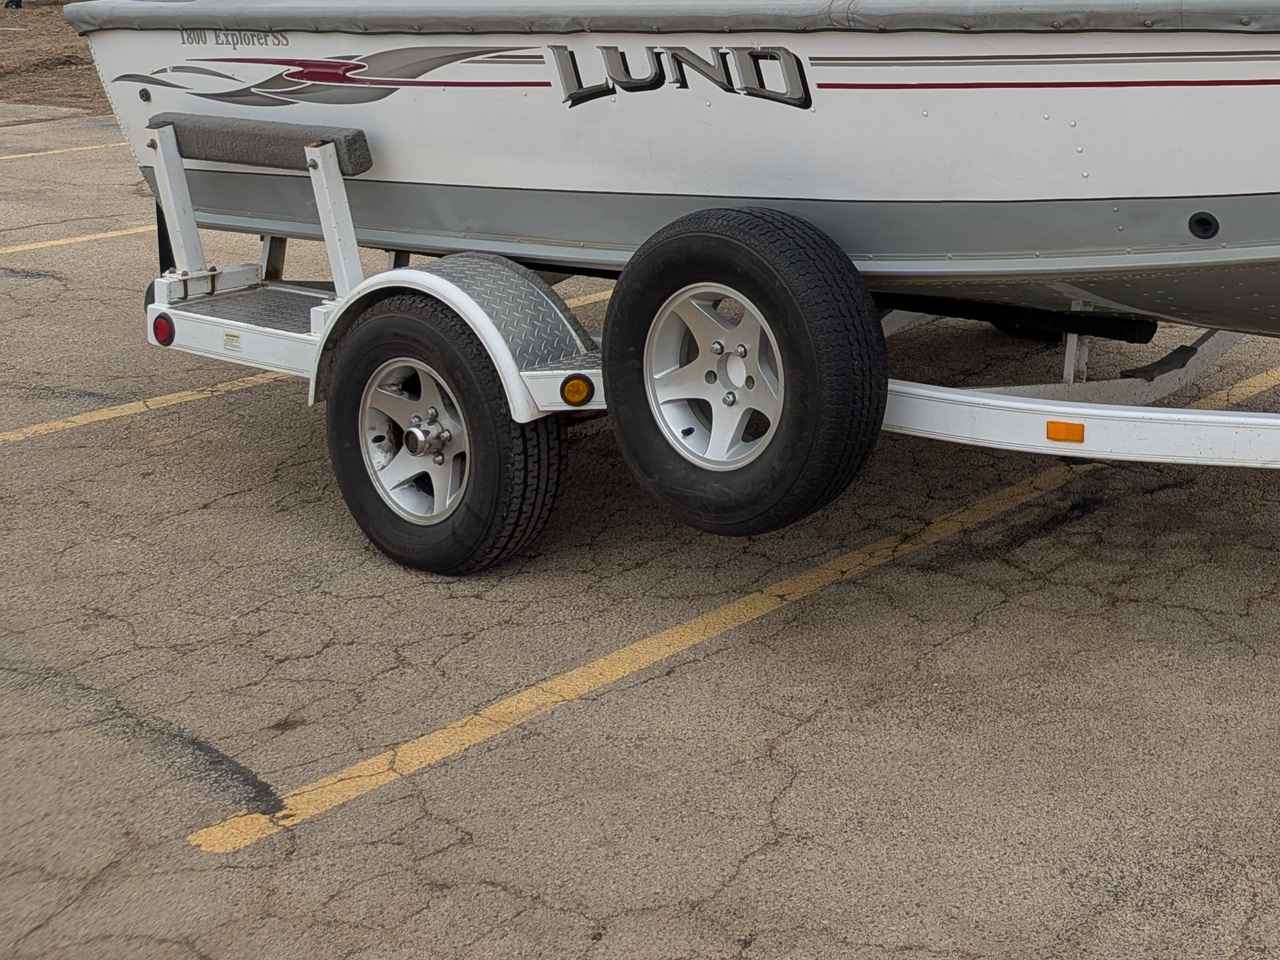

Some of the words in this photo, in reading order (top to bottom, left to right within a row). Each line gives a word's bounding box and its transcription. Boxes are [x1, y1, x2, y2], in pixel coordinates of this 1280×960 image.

[180, 29, 208, 45] 1800
[215, 30, 270, 50] Explorer
[271, 31, 290, 47] SS
[547, 44, 812, 110] LUND
